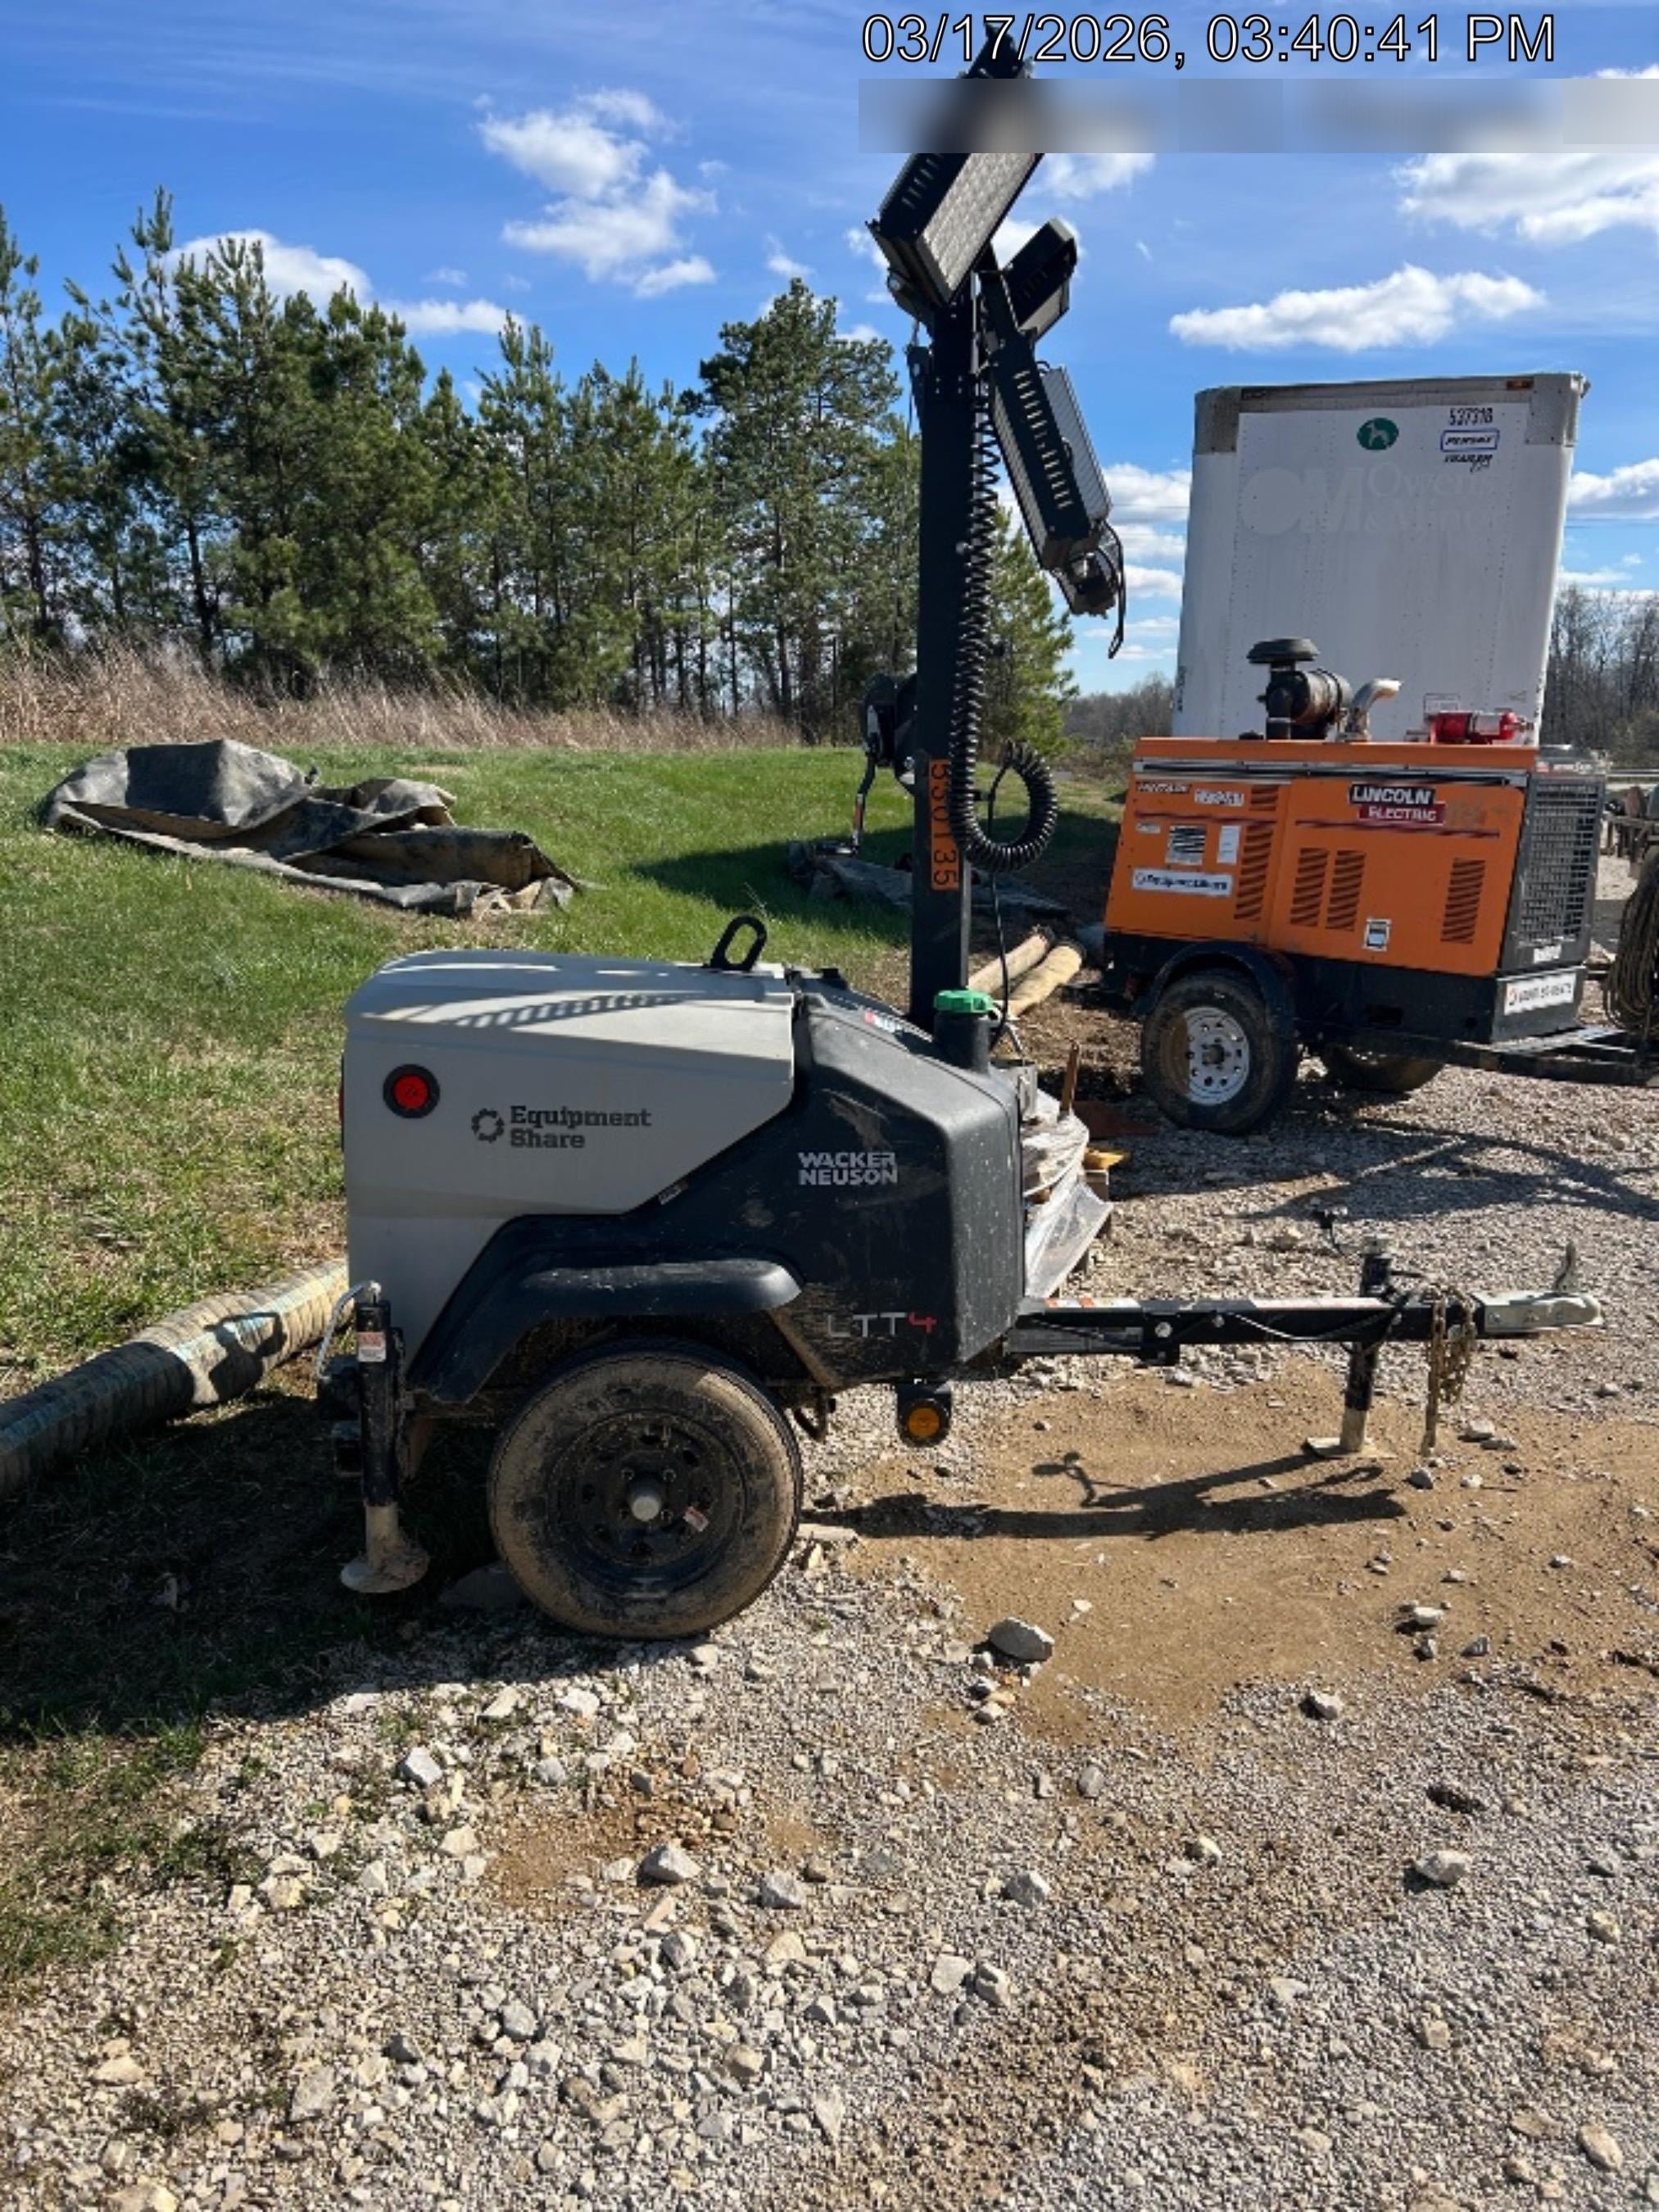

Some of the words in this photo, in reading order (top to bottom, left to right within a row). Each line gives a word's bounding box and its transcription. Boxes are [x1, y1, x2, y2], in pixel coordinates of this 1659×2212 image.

[1353, 785, 1432, 805] LINCOLN
[1368, 806, 1437, 822] ELECTRIC
[510, 1105, 653, 1129] Equipment
[510, 1127, 586, 1148] Share
[798, 1151, 896, 1168] WACKER
[799, 1168, 898, 1185] NEUSON
